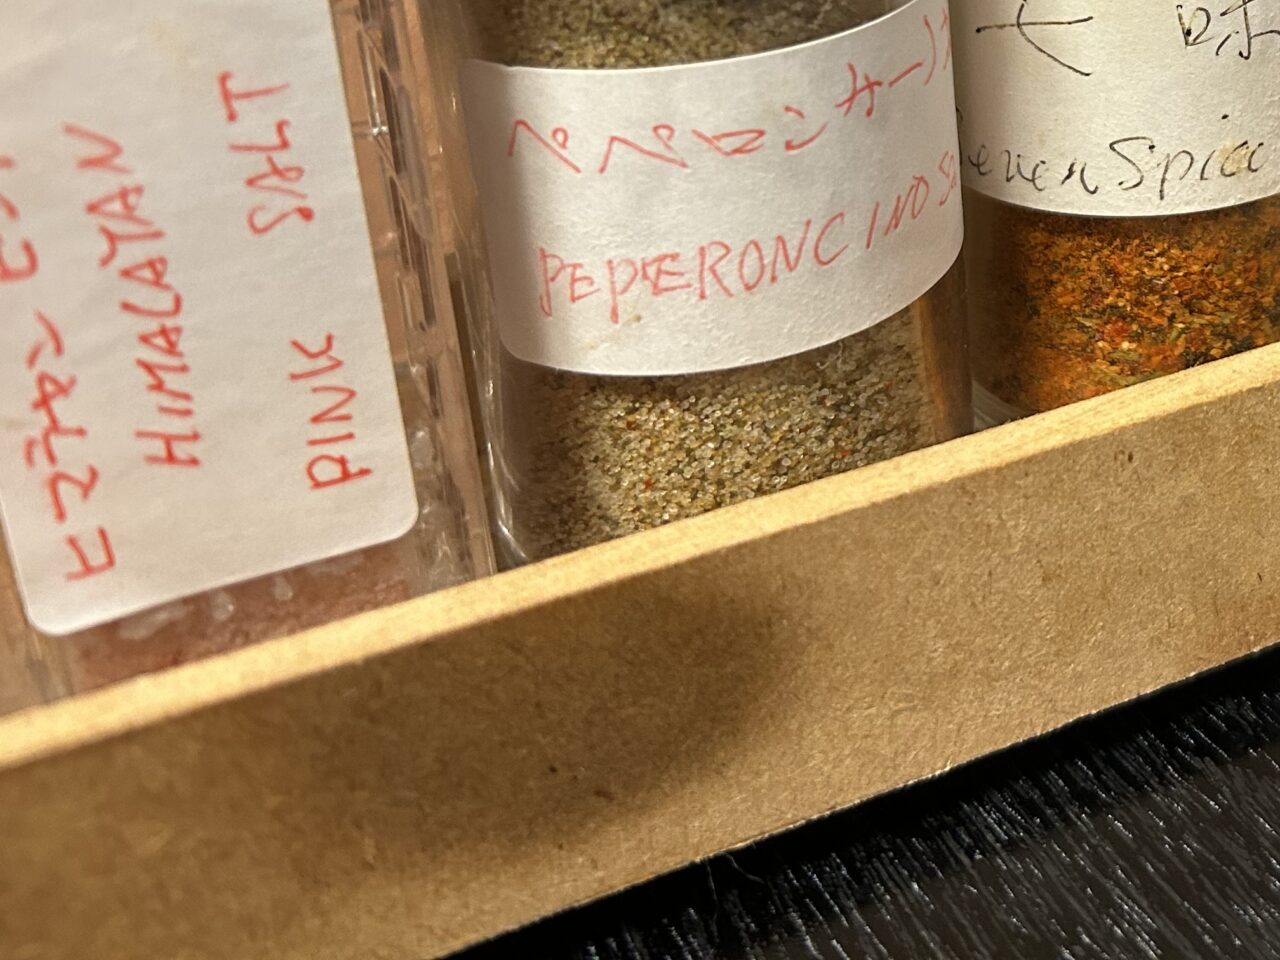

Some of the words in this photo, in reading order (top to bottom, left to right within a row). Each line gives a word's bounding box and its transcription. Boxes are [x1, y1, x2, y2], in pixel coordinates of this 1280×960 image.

[216, 70, 315, 235] SALT
[957, 140, 1099, 196] even
[61, 121, 202, 468] HIMALAYAN
[287, 332, 373, 491] PINK
